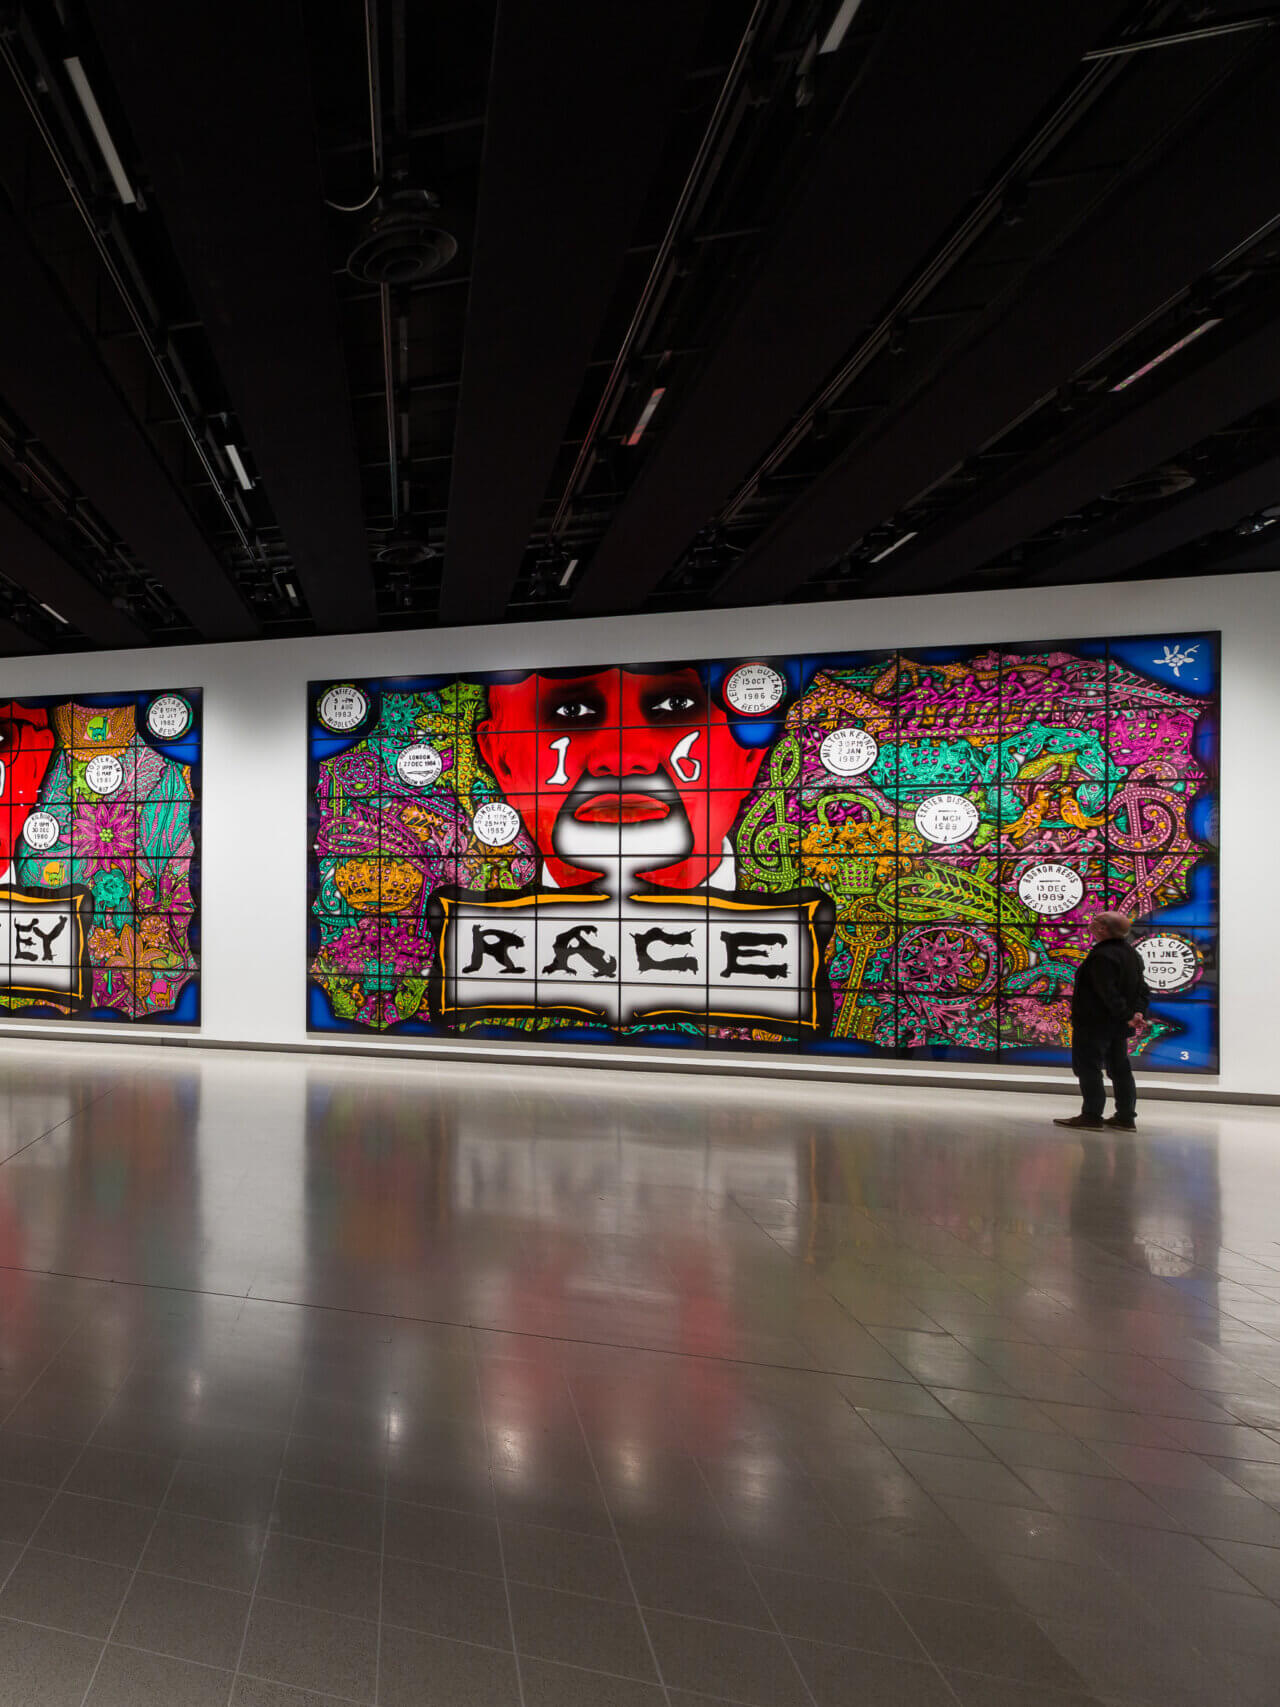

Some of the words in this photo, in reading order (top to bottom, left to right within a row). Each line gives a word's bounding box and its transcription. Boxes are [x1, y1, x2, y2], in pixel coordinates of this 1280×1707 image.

[728, 669, 754, 703] LEIGHTON
[756, 669, 782, 701] BUZZARD
[751, 677, 767, 685] OCT
[330, 688, 357, 698] ENFIELD
[328, 715, 361, 728] MIDDLESEX
[822, 731, 847, 758] MILTON
[849, 730, 876, 756] KEYNES
[846, 747, 861, 755] JAN
[917, 796, 943, 818] EXETER
[946, 796, 977, 818] DISTRICT
[474, 803, 519, 825] SUNDERLAND
[492, 836, 499, 845] A
[1023, 865, 1054, 883] BOGNOR
[1055, 866, 1079, 884] REGIS
[1047, 884, 1067, 892] DEC
[1038, 893, 1065, 901] 1989
[1023, 893, 1044, 911] WEST
[1047, 894, 1079, 913] SUSSEX
[461, 924, 792, 980] RACE
[1147, 950, 1156, 959] 11
[1159, 950, 1179, 959] JNE
[1147, 966, 1177, 975] 1990
[1179, 1050, 1190, 1061] 3
